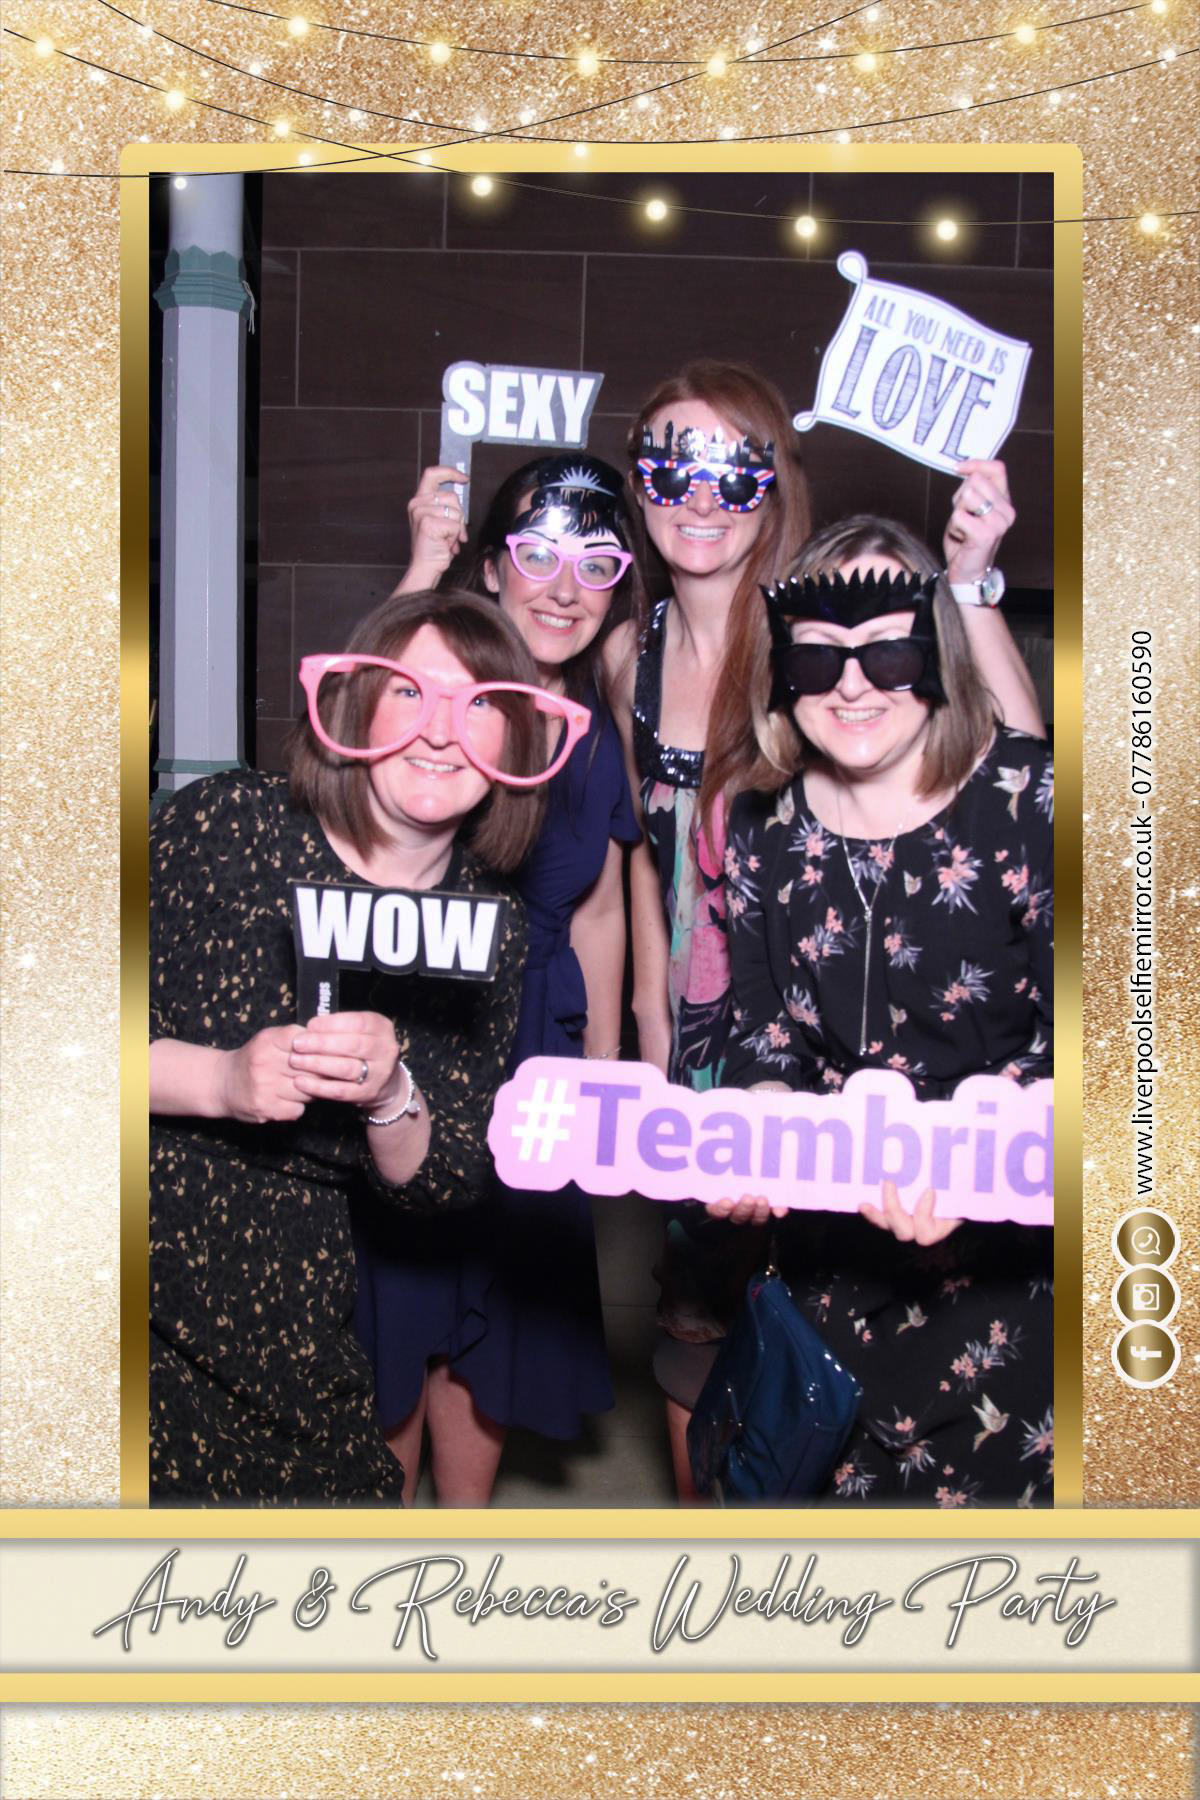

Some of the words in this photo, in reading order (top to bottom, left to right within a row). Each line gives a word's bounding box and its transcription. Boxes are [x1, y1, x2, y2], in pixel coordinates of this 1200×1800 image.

[864, 295, 896, 329] ALL
[903, 308, 941, 345] YOU
[941, 326, 988, 366] NEED
[988, 346, 1009, 376] IS
[448, 367, 596, 443] SEXY
[831, 323, 996, 462] LOVE
[296, 887, 498, 972] WOW
